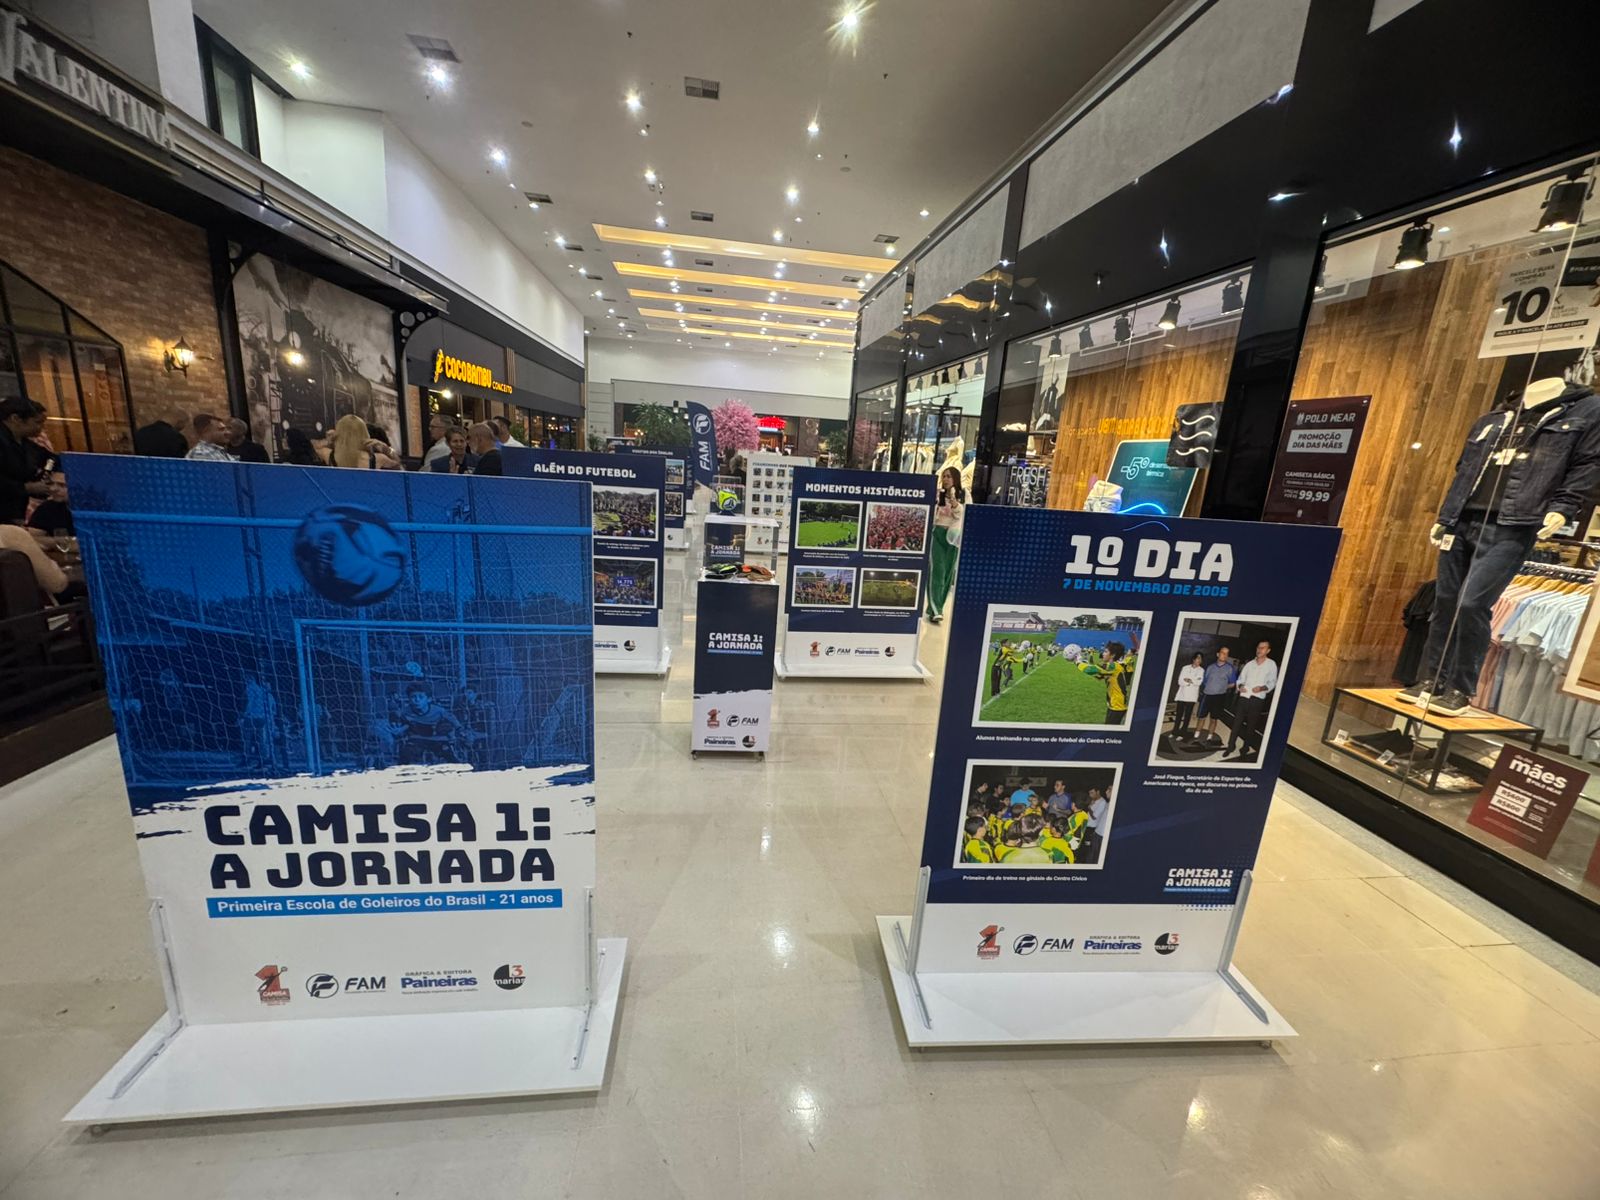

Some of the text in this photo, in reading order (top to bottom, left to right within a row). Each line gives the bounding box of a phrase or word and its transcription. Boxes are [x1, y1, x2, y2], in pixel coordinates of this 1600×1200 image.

[1304, 412, 1356, 423] POLO WEAR
[1298, 432, 1341, 442] PROMOÇÃO
[700, 441, 711, 470] FAM
[534, 462, 636, 480] ALÉM DO FUTEBOL
[1010, 466, 1047, 488] FRESH
[1313, 472, 1335, 480] BÁSICA
[805, 483, 926, 498] MOMENTOS HISTÓRICOS
[1007, 486, 1031, 506] FIVE
[1298, 490, 1330, 502] 99,99
[1134, 538, 1234, 582] DIA
[1062, 578, 1229, 597] 7 DE NOVEMBRO DE 2005
[710, 632, 763, 644] CAMISA 1:
[718, 642, 763, 650] JORNADA
[1509, 759, 1568, 789] mães
[204, 802, 550, 846] CAMISA 1:
[210, 848, 555, 889] A JORNADA
[1168, 868, 1234, 878] CAMISA 1:
[1166, 878, 1231, 887] A JORNADA
[218, 900, 282, 912] Primeira
[286, 898, 334, 910] Escola
[339, 896, 358, 909] de
[361, 894, 420, 908] Goleiros
[425, 894, 442, 907] do
[446, 893, 486, 906] Brasil
[500, 892, 516, 904] 21
[520, 894, 554, 904] anos
[1042, 938, 1074, 949] FAM
[1169, 933, 1179, 943] 3
[1084, 940, 1142, 950] Paineiras
[511, 965, 524, 976] 3
[344, 976, 386, 990] FAM
[401, 976, 478, 988] Paineiras
[495, 978, 525, 986] marias
